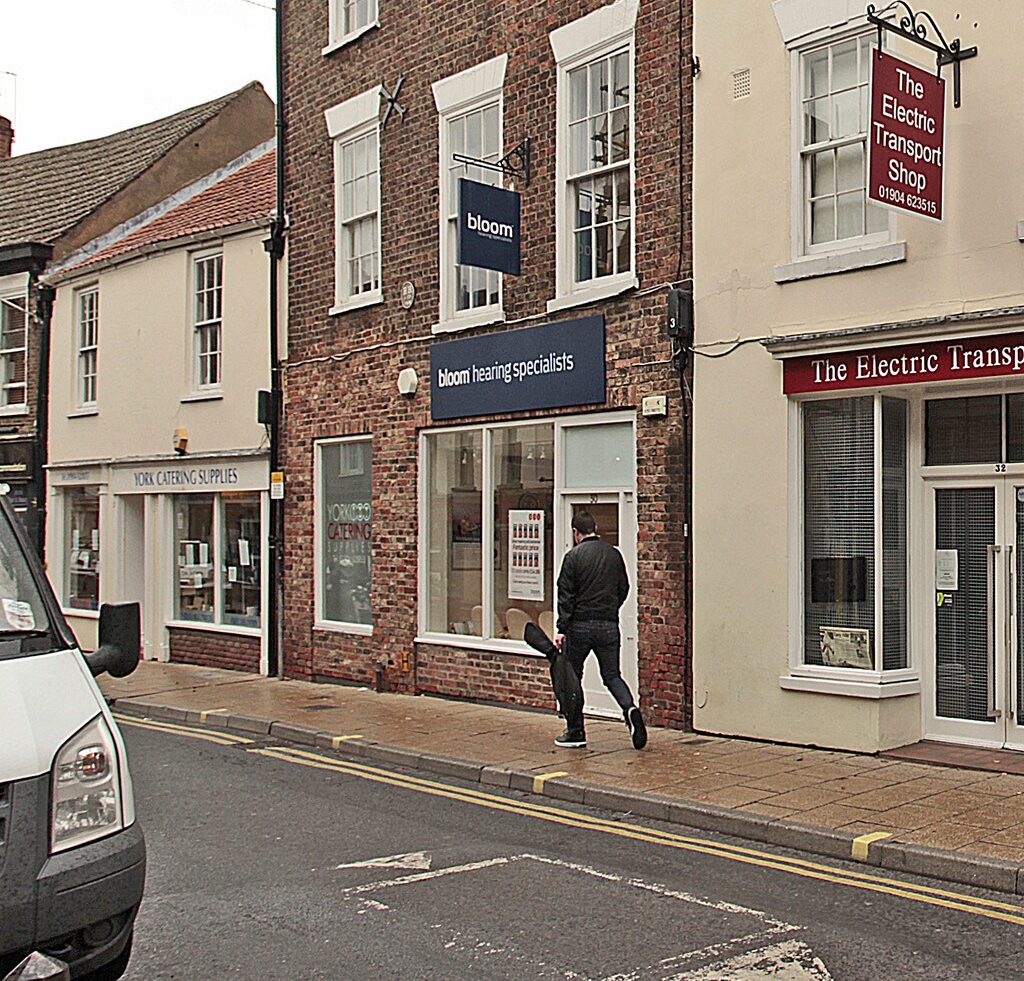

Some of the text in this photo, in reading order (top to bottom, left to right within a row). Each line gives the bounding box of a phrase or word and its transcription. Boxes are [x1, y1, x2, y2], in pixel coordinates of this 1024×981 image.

[895, 68, 924, 99] The
[882, 94, 936, 134] Electric
[873, 121, 942, 167] Transport
[888, 159, 927, 194] Shop
[878, 185, 937, 214] 01904 623515
[467, 212, 513, 238] bloom
[438, 352, 574, 388] bloom hearing specialists
[811, 359, 848, 383] The
[855, 348, 939, 379] Electric
[134, 468, 239, 486] YORK CATERING SUPPLIES
[995, 464, 1006, 473] 32
[327, 522, 372, 541] CATERING
